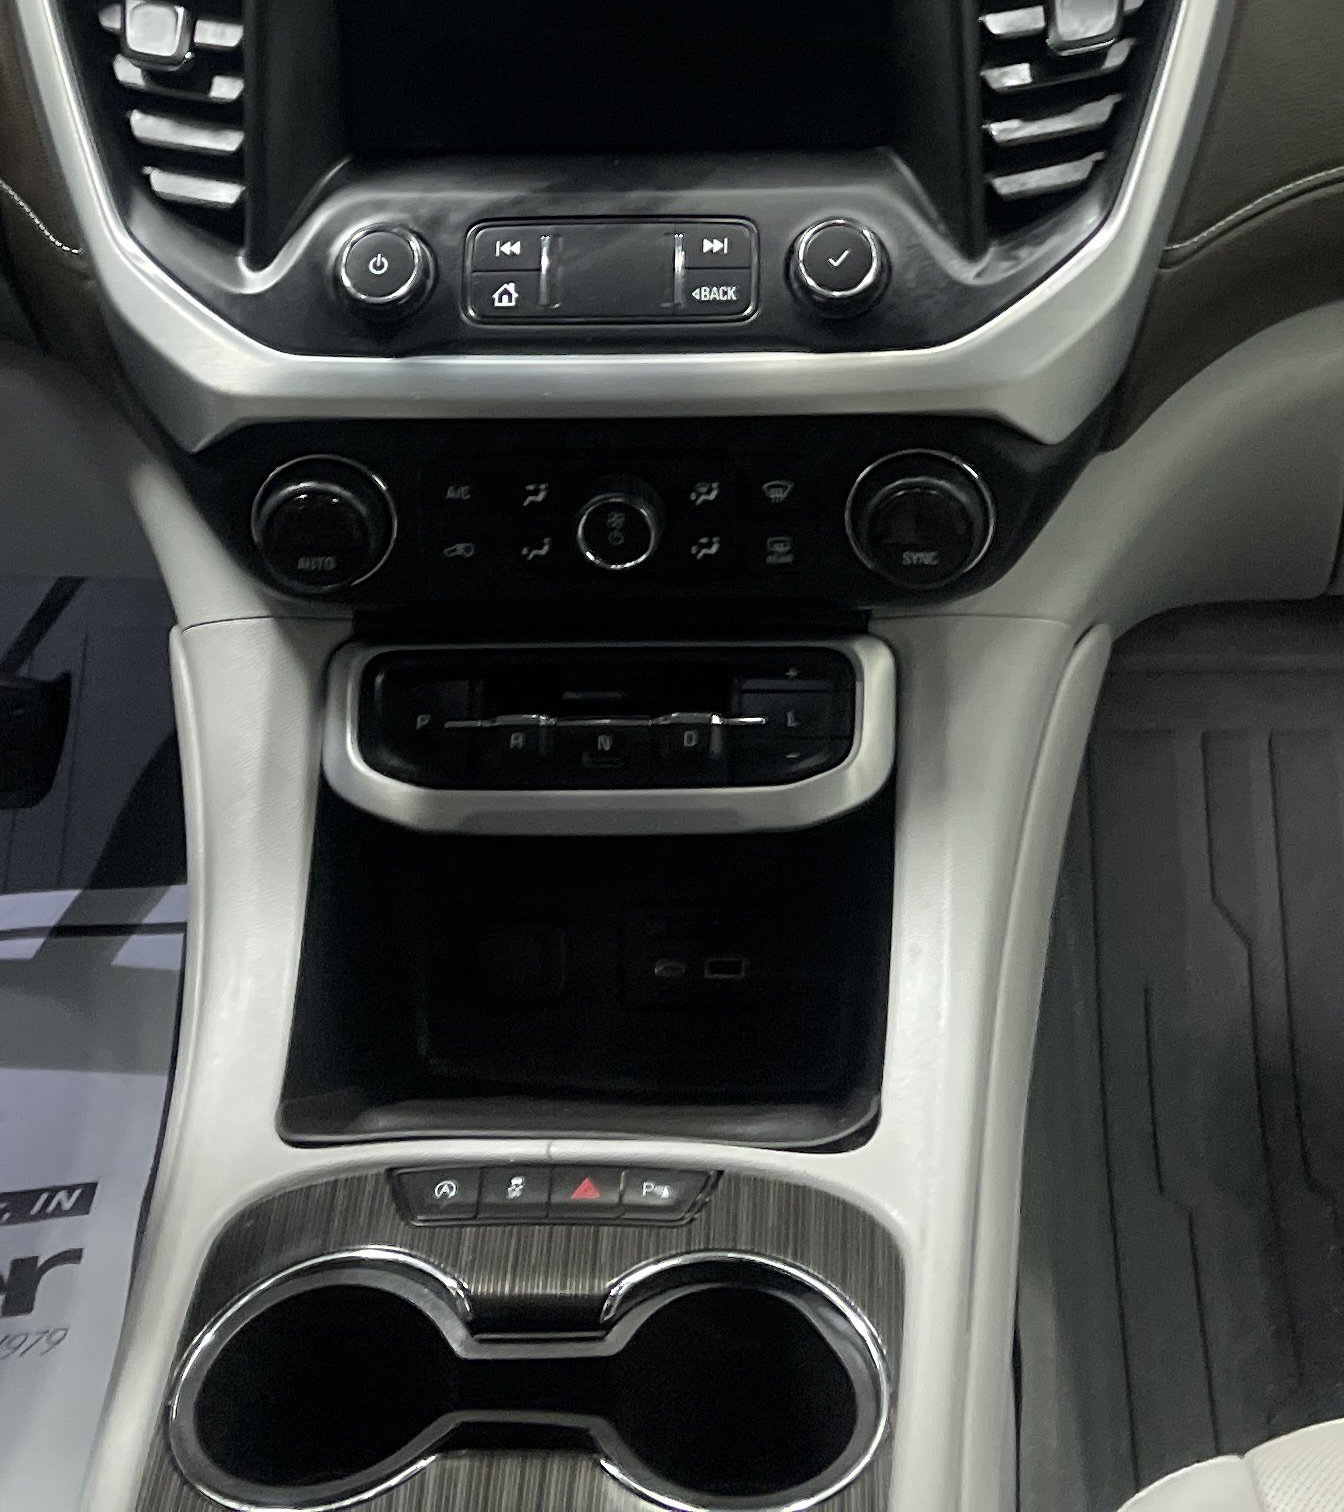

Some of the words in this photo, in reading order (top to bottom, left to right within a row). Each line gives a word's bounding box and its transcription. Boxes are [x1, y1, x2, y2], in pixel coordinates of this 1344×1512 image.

[701, 286, 737, 301] BACK
[902, 551, 940, 566] SYNC
[29, 1187, 84, 1216] IN
